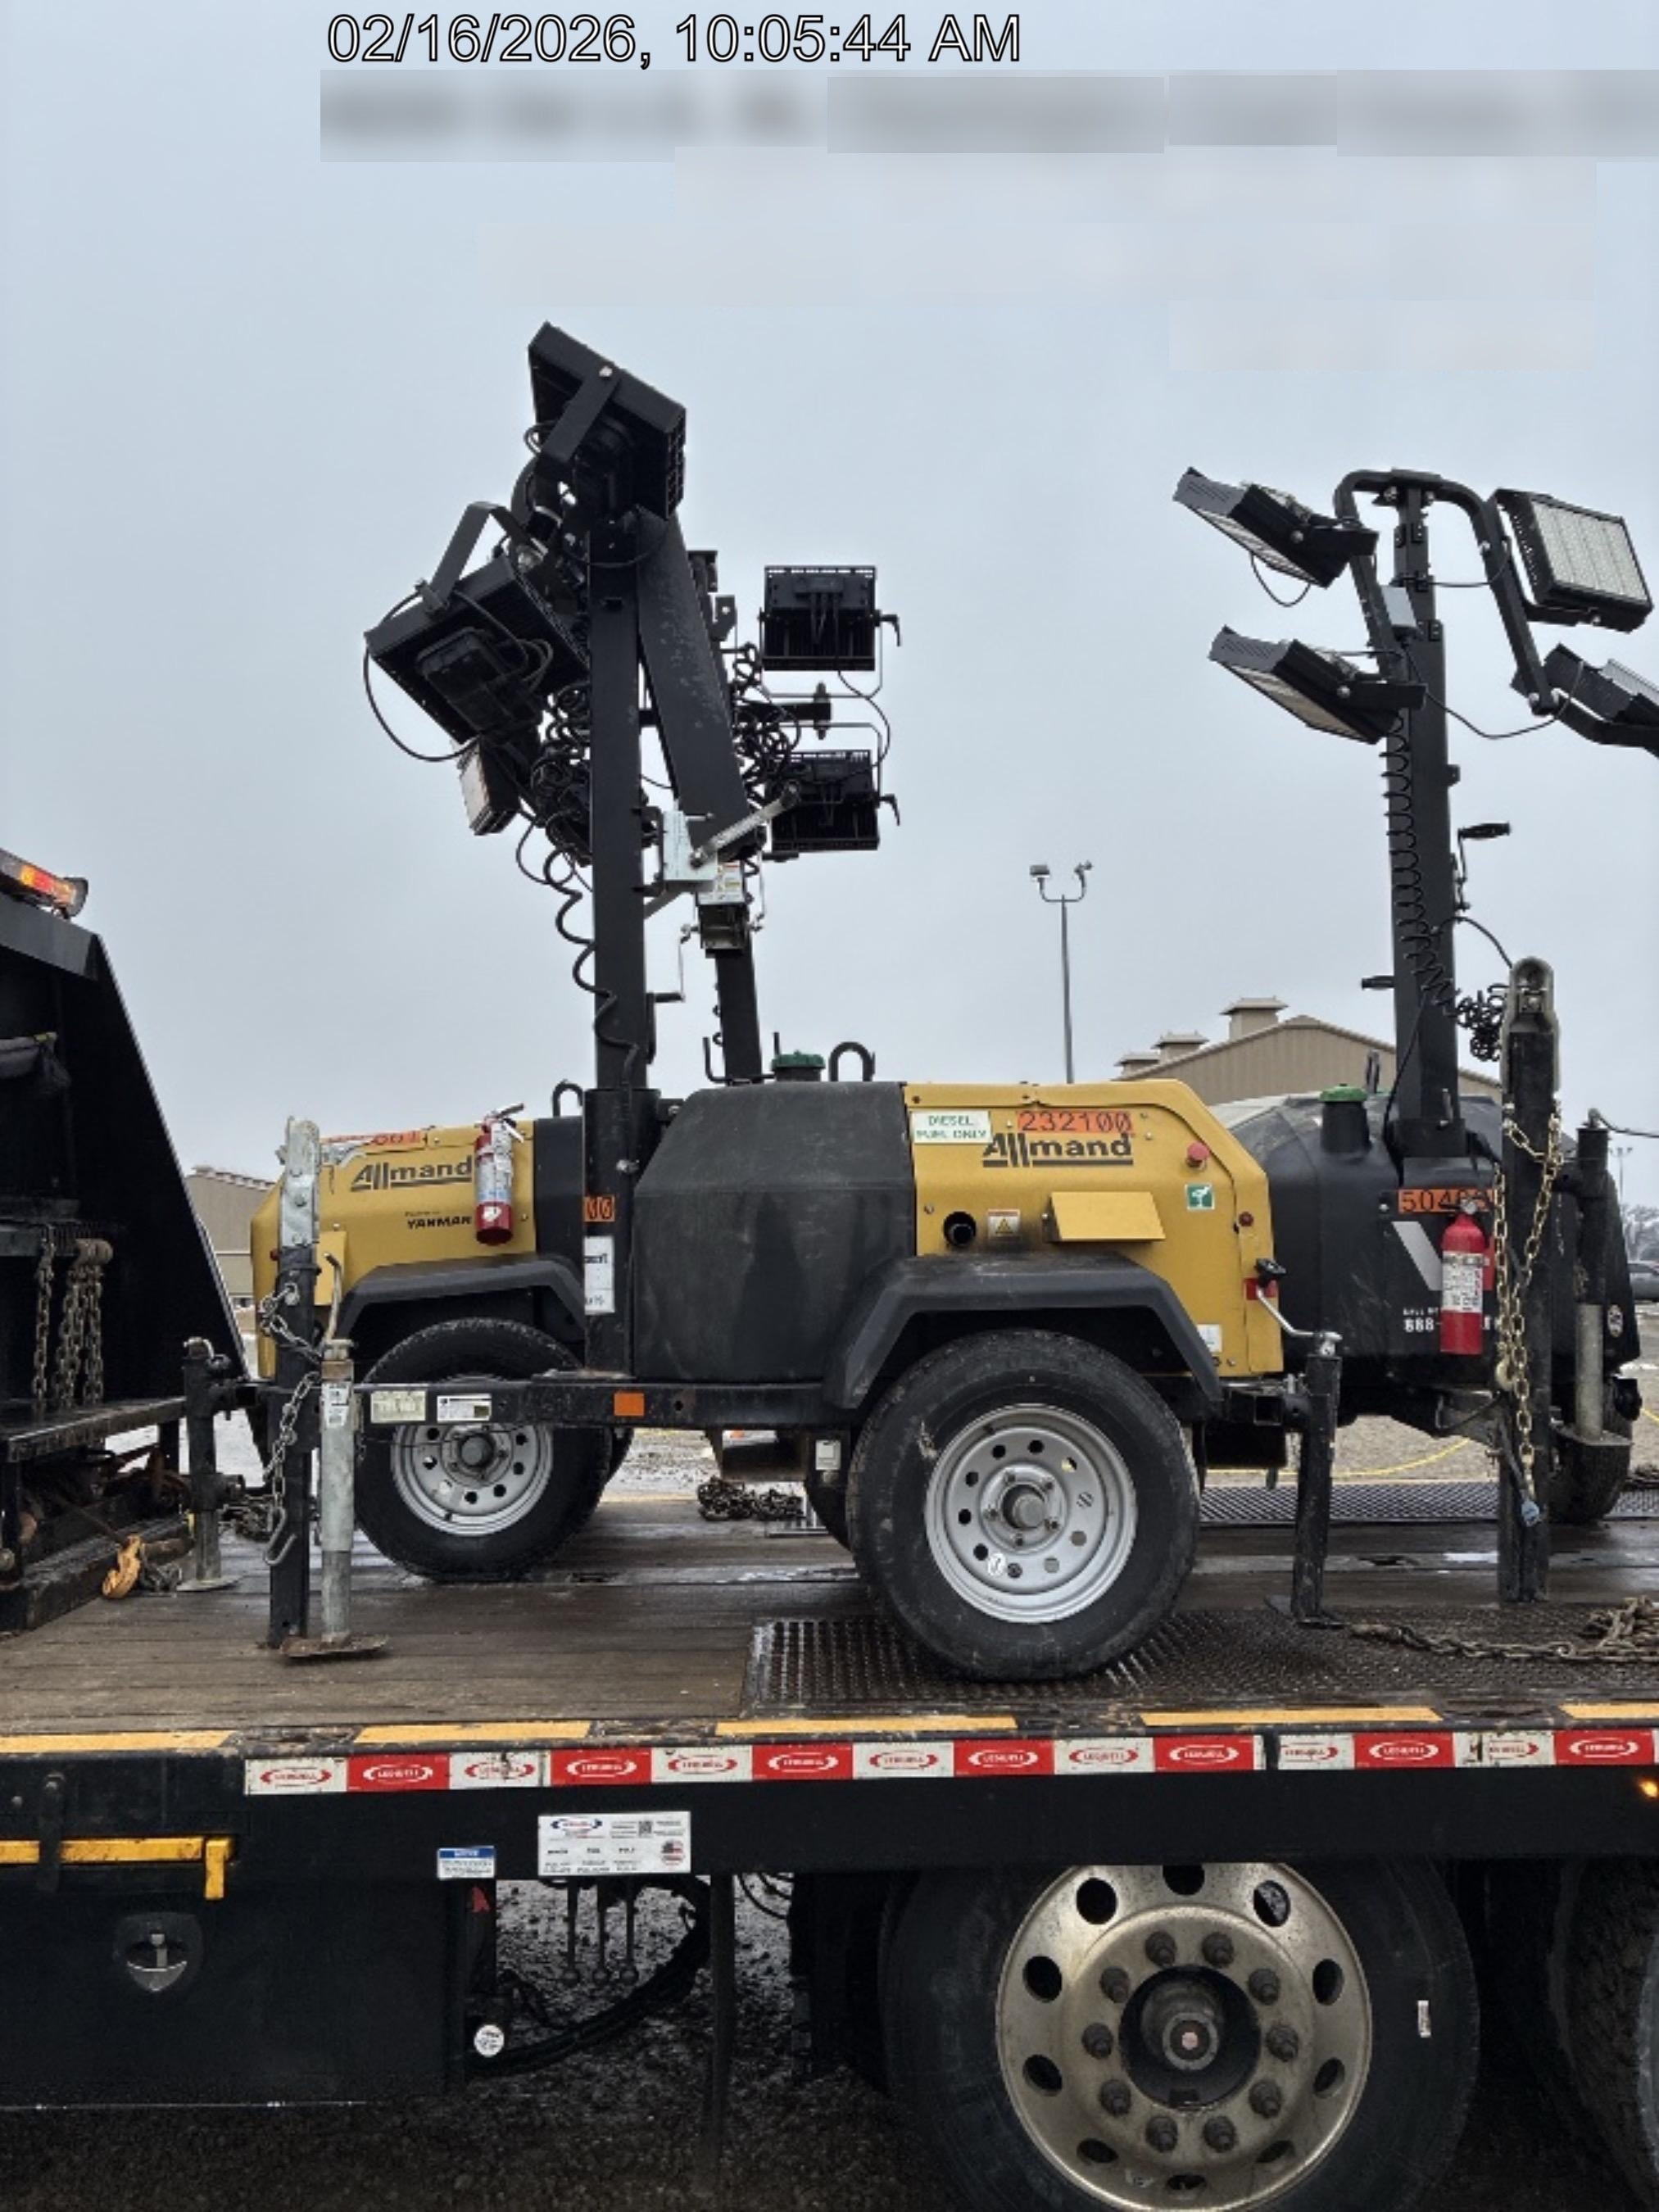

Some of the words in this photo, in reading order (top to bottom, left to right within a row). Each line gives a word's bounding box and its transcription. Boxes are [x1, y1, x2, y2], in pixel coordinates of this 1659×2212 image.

[928, 1115, 974, 1126] DIESEL
[1022, 1111, 1132, 1131] 232100
[982, 1132, 1133, 1167] Allmand
[351, 1155, 474, 1191] Allmand
